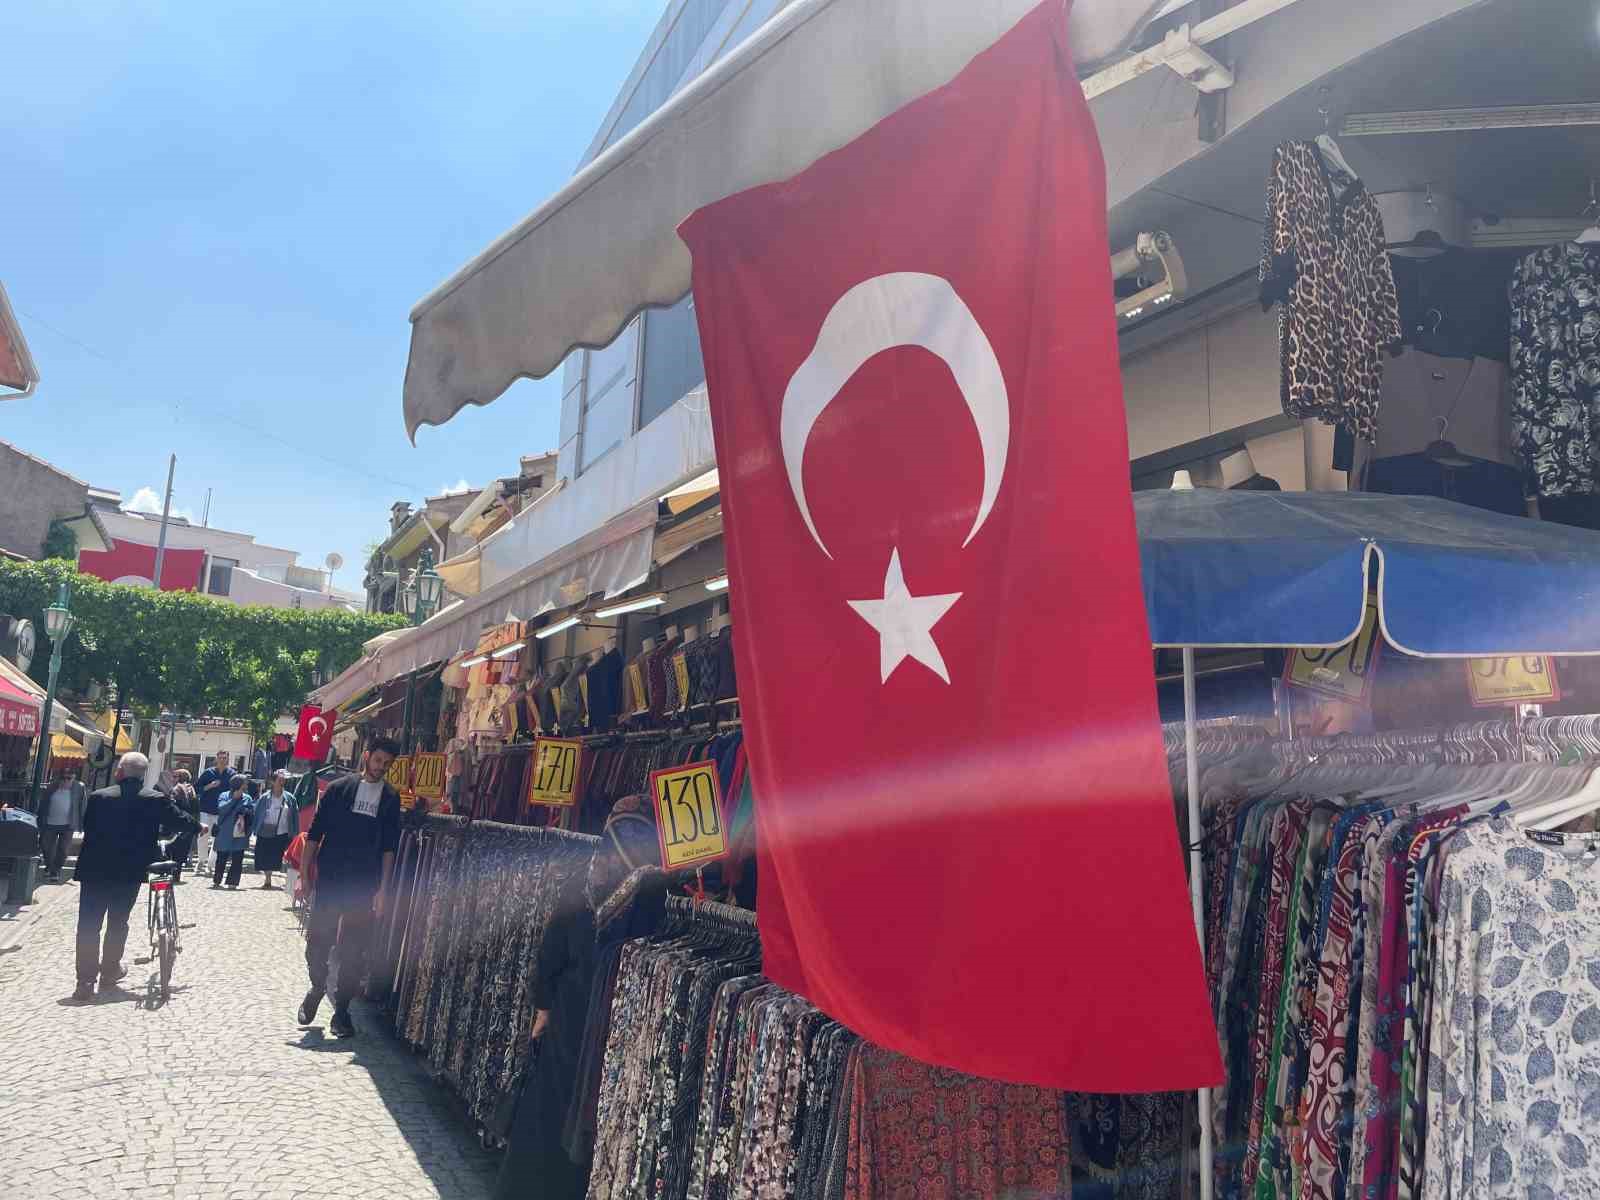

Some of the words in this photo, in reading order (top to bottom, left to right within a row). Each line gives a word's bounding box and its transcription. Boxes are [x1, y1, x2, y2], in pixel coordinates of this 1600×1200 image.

[416, 758, 443, 787] 200
[534, 745, 576, 793] 170
[663, 772, 719, 846] 130
